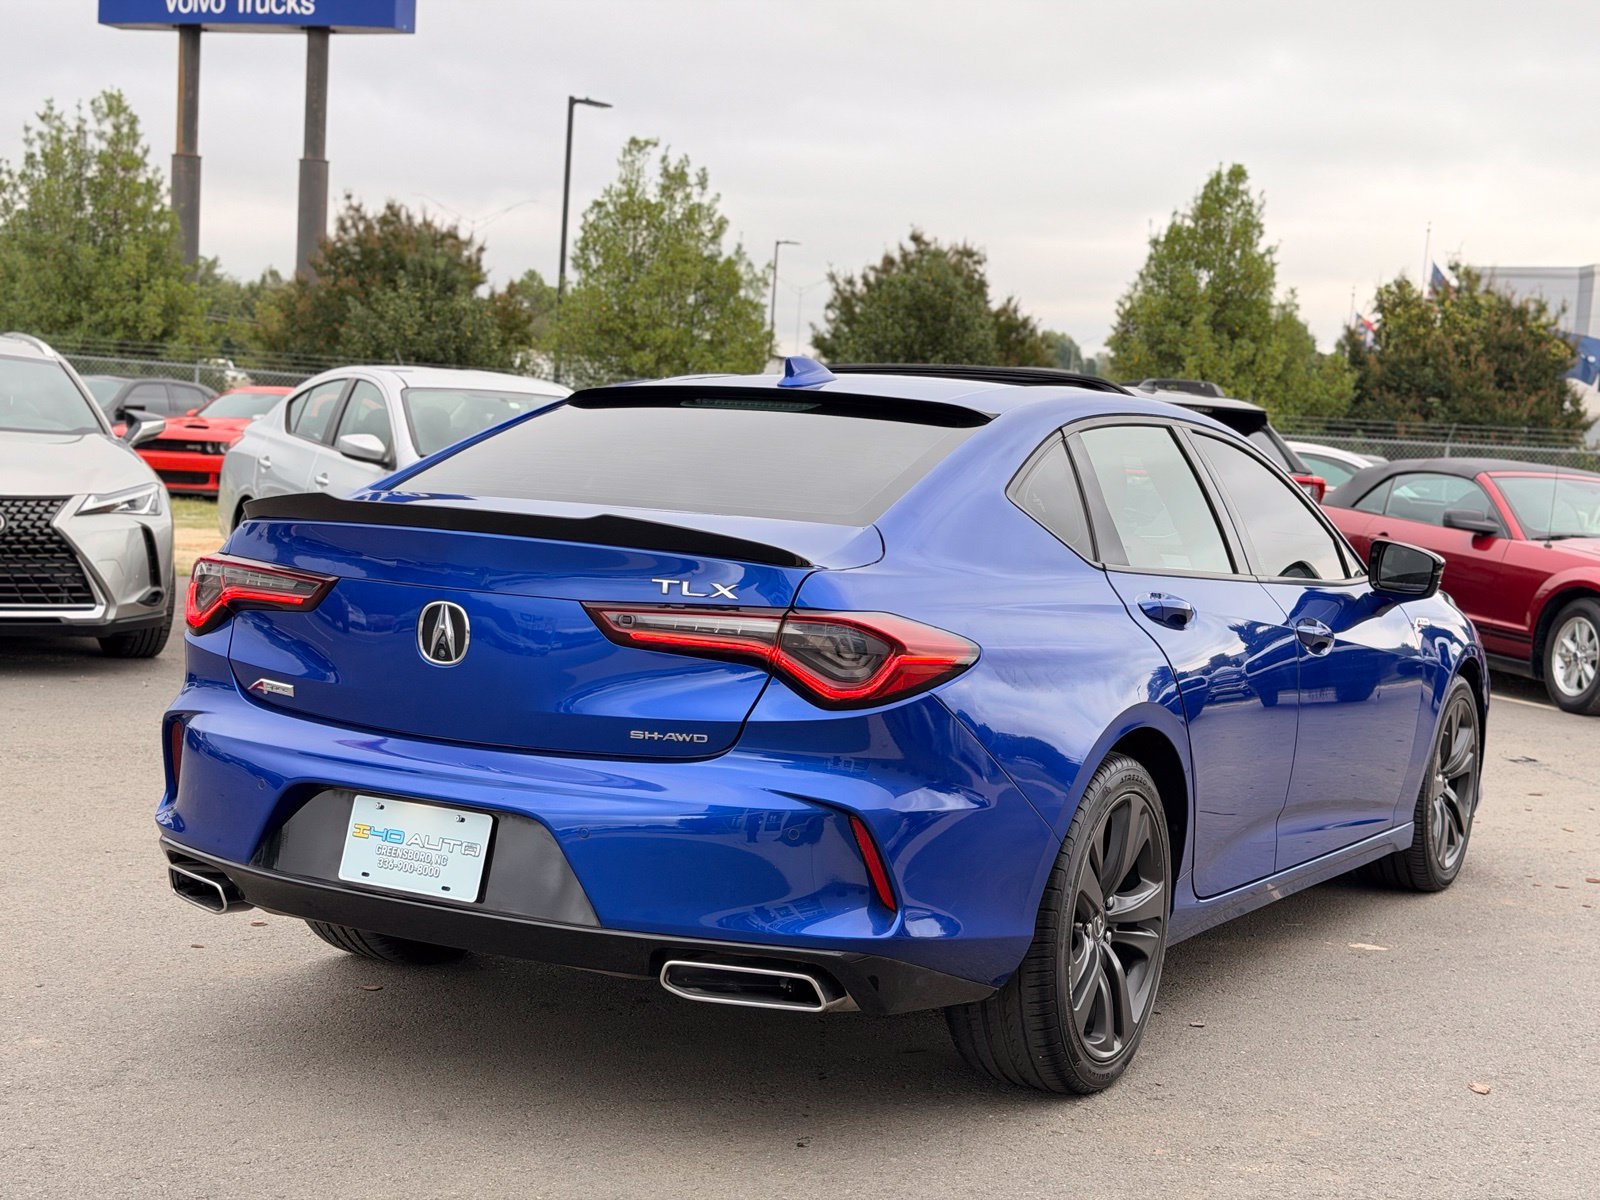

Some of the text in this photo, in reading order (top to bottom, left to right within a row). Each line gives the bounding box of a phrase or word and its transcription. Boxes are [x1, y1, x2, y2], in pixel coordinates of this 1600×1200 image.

[651, 578, 739, 600] TLX
[629, 730, 709, 743] SH-AWD
[352, 823, 405, 845] I40
[377, 857, 441, 878] 336-900-8000
[434, 854, 448, 866] NC
